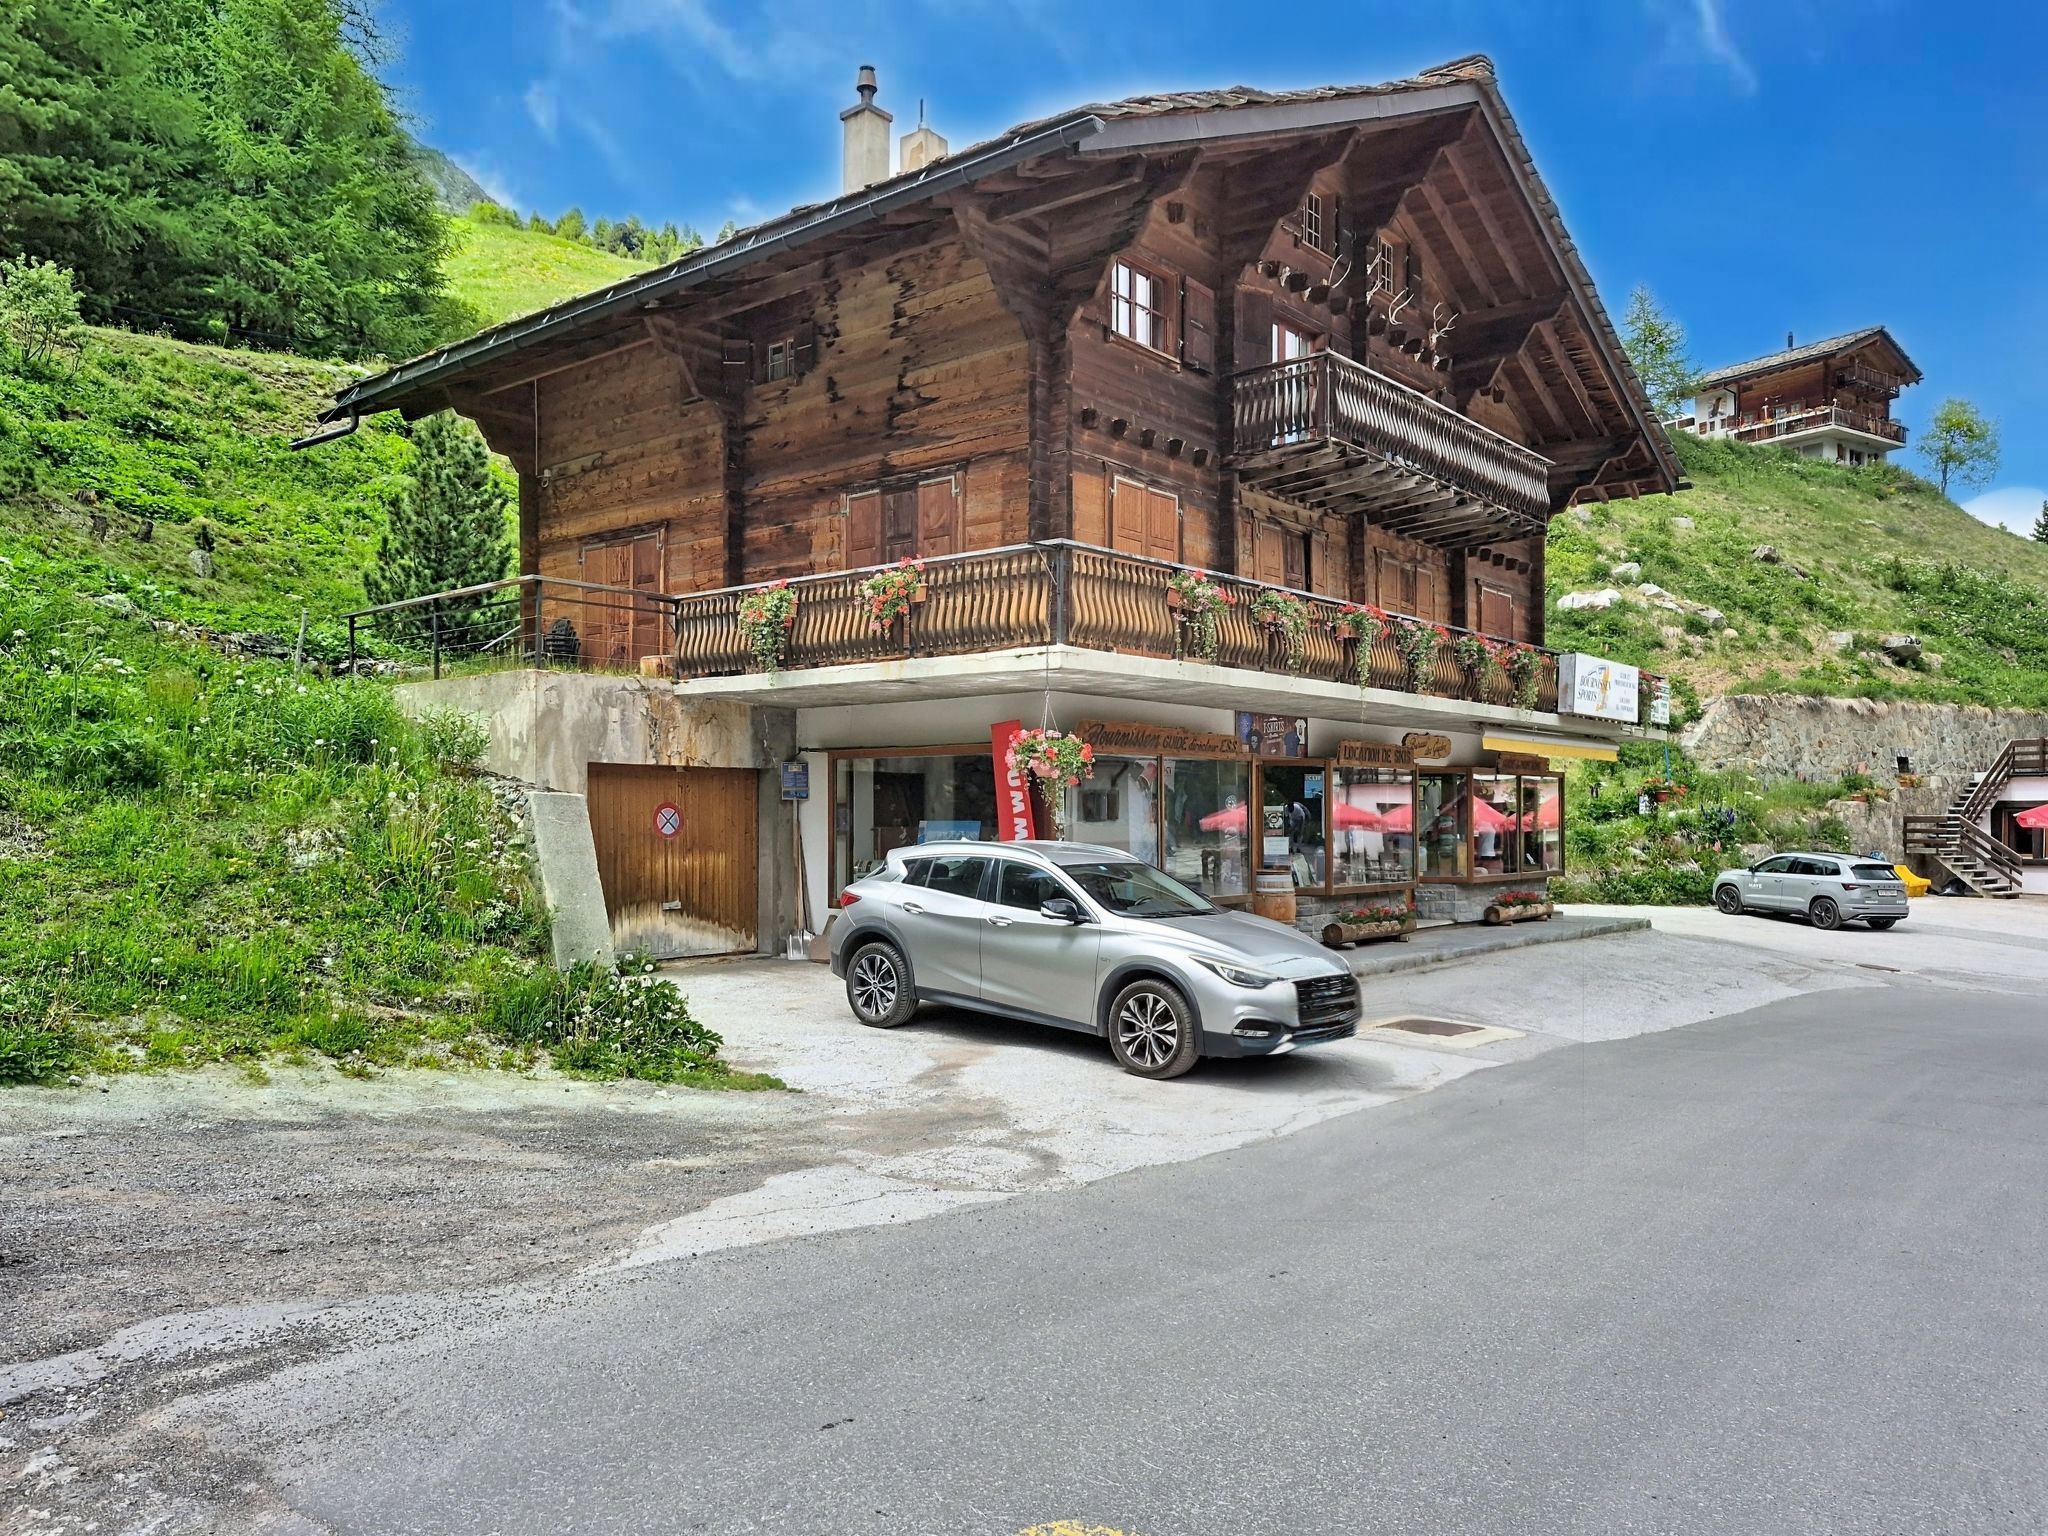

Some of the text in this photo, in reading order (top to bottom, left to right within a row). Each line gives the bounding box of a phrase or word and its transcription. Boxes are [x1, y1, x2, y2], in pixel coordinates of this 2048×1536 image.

[1577, 688, 1598, 702] SPORTS
[1263, 721, 1284, 733] T-SHIRTS
[1162, 734, 1189, 752] GUIDE
[1343, 744, 1380, 763] LOCATION
[1381, 747, 1393, 764] DE
[1393, 748, 1412, 765] SKIS
